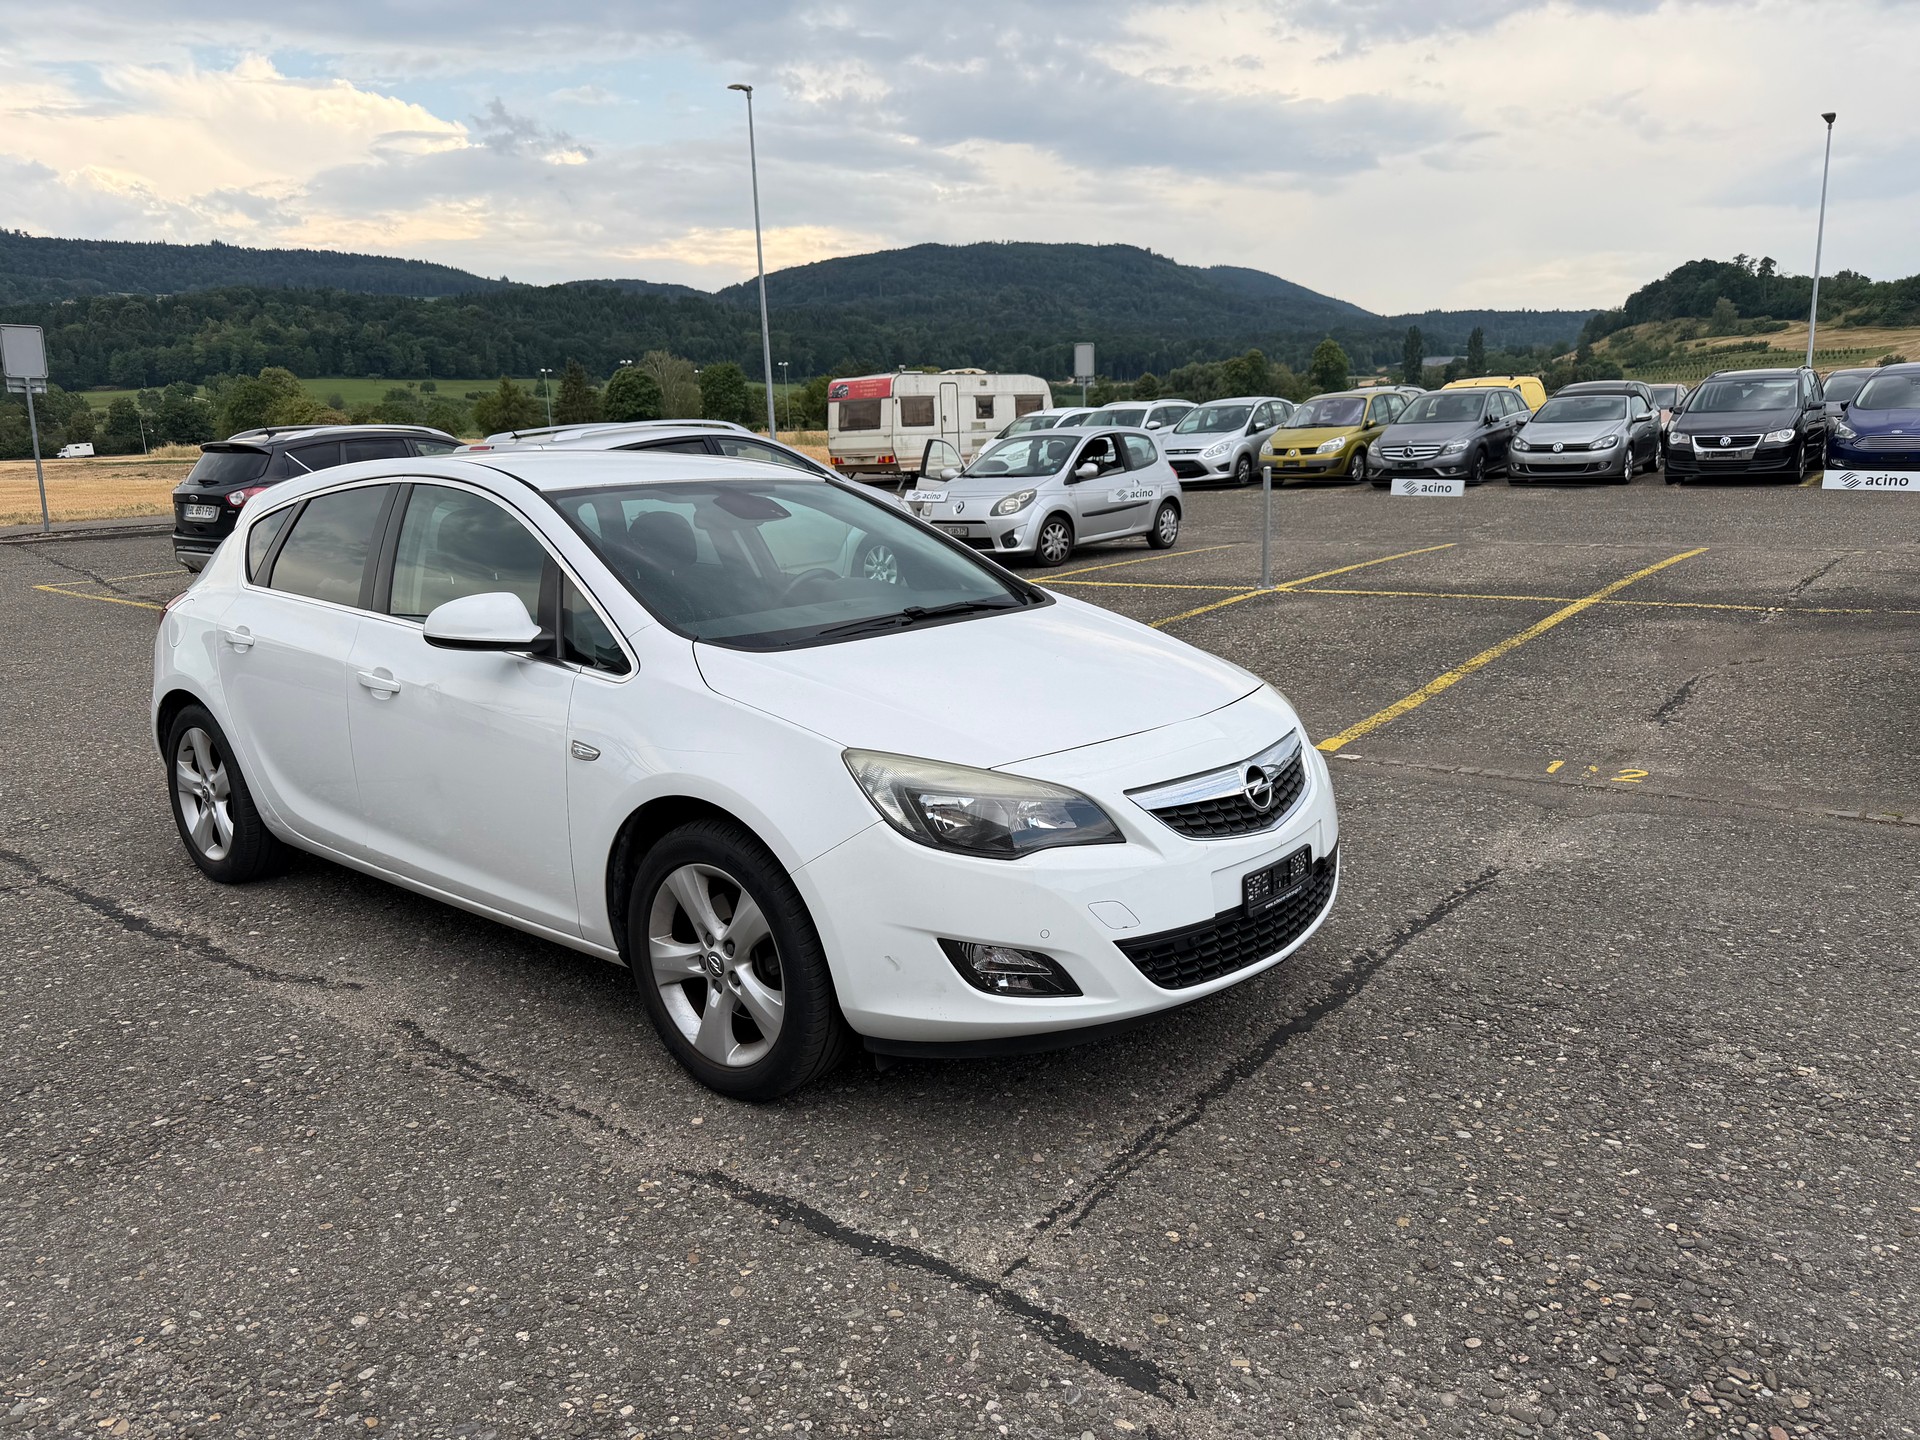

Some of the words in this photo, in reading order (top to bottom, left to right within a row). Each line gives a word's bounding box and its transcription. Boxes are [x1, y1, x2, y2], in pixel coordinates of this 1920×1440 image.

[1865, 474, 1909, 487] acino
[1421, 482, 1452, 493] acino
[922, 492, 941, 500] acino
[1130, 489, 1153, 498] acino
